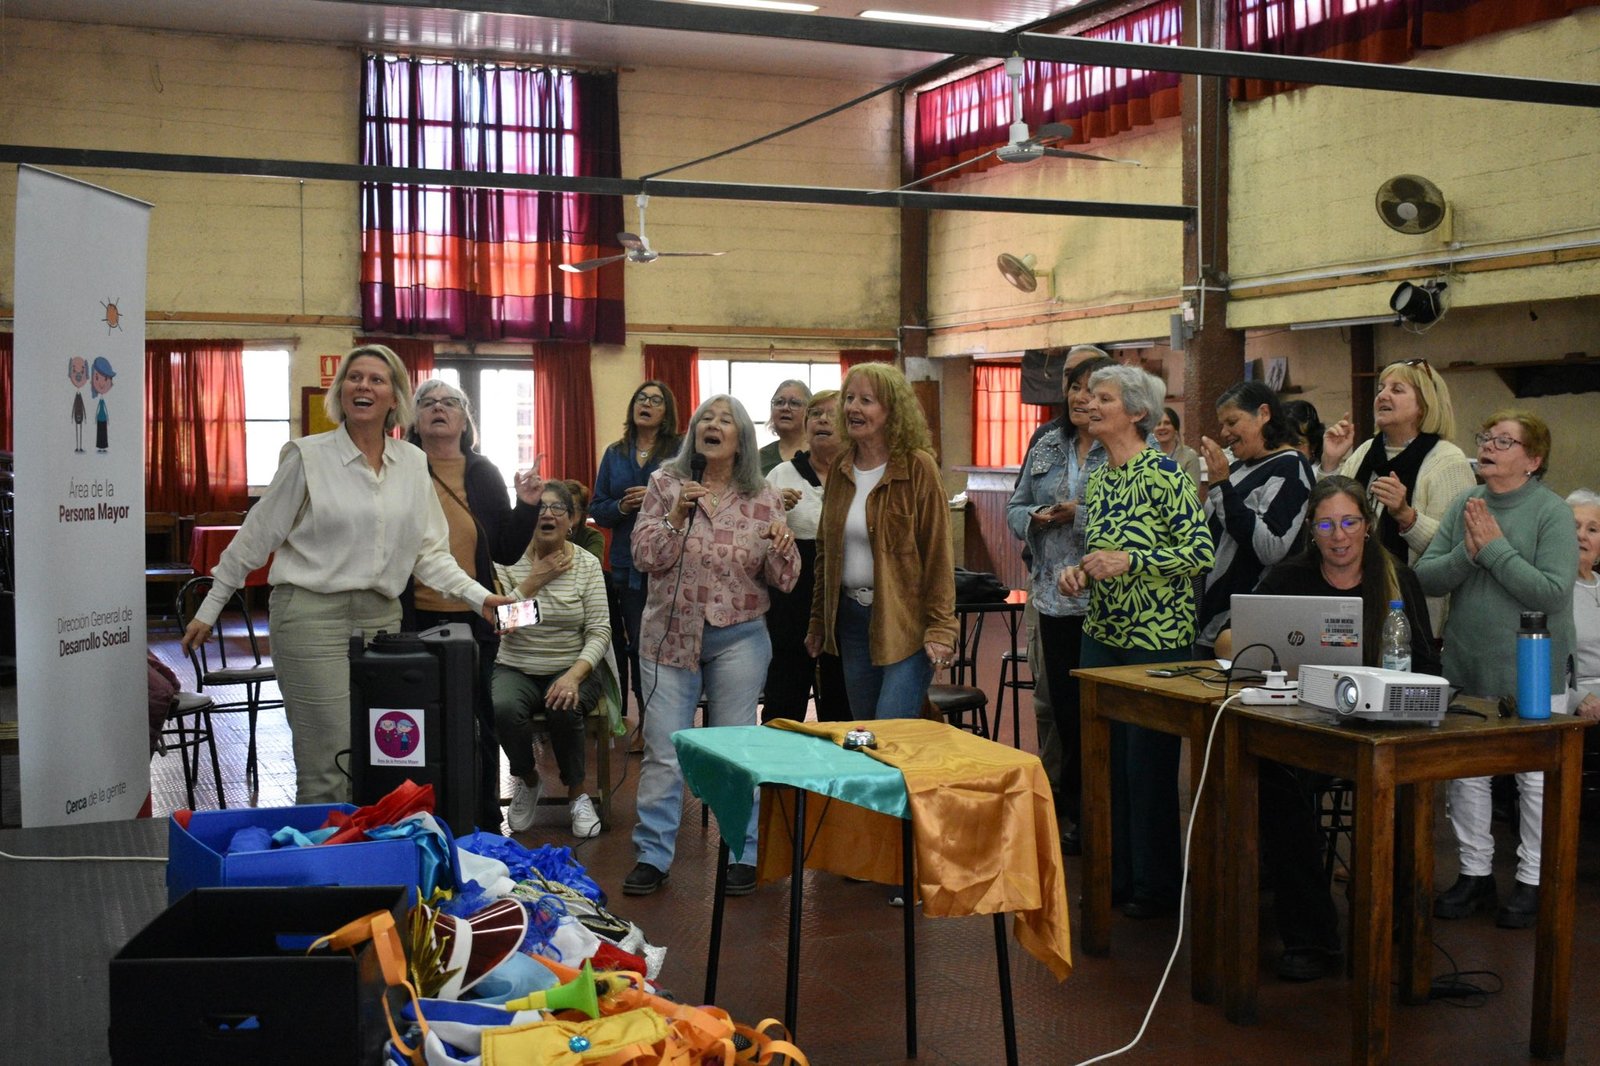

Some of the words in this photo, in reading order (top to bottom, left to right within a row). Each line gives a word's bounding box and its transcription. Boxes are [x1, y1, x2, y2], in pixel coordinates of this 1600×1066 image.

[69, 476, 88, 498] Área
[91, 480, 103, 498] de
[105, 479, 114, 497] la
[59, 505, 95, 523] Persona
[98, 502, 129, 524] Mayor
[91, 608, 120, 627] General
[121, 605, 133, 622] de
[59, 631, 100, 657] Desarrollo
[102, 625, 130, 647] Social
[1288, 631, 1305, 646] hp
[66, 797, 87, 815] Cerca
[88, 791, 98, 806] de
[99, 788, 105, 801] la
[106, 782, 126, 803] gente
